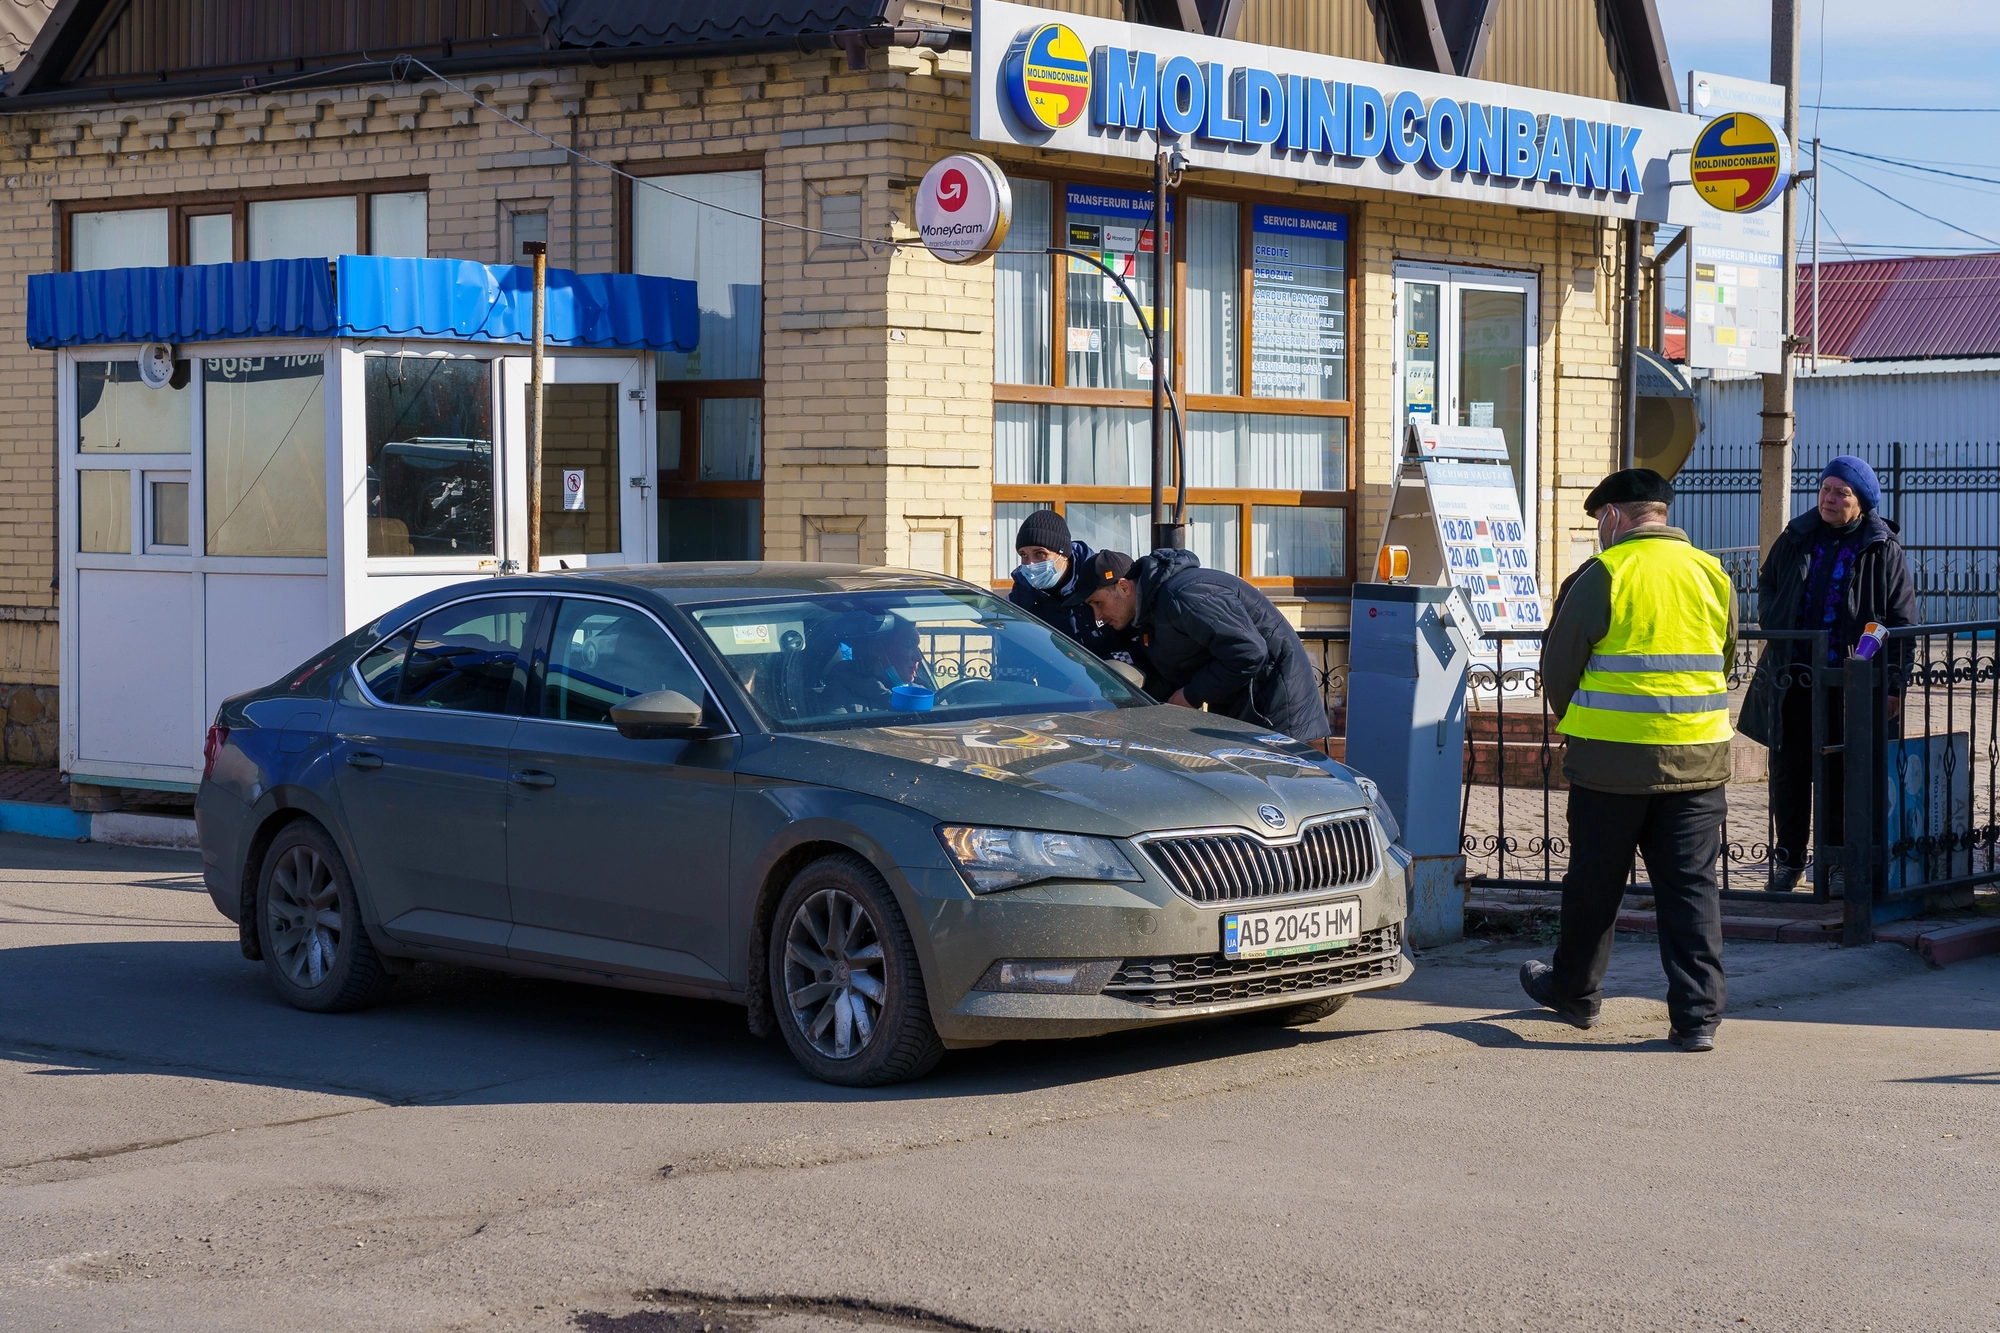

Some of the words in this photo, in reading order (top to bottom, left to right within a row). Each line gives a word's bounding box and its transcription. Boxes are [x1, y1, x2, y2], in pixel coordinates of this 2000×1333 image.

[1027, 67, 1089, 85] MOLDINDCONBANK
[1035, 96, 1046, 105] S.A.
[1712, 86, 1783, 109] MOLDINDCONBANK
[1103, 45, 1645, 196] MOLDINDCONBANK
[1694, 155, 1777, 170] MOLDINDCONBANK
[1704, 185, 1718, 193] S.A.
[1067, 193, 1130, 209] TRANSFERURI
[1263, 215, 1298, 228] SERVICII
[1300, 218, 1338, 232] BANCARE
[928, 238, 952, 248] transfer
[952, 238, 961, 246] de
[961, 237, 974, 246] bani
[1111, 235, 1133, 243] MoneyGram
[1255, 245, 1289, 258] CREDITE
[1697, 246, 1748, 262] TRANSFERURI
[1255, 267, 1294, 281] DEPOZITE
[1254, 289, 1291, 303] CARDURI
[1291, 292, 1328, 307] BANCARE
[1254, 311, 1290, 323] SERVICII
[1290, 313, 1334, 328] COMUNALE
[1254, 332, 1309, 347] TRANSFERURI
[1254, 361, 1288, 372] SERVICII
[1289, 362, 1300, 373] DE
[1436, 468, 1469, 480] SCHIMB
[1470, 470, 1508, 481] VALUTAR
[1239, 918, 1270, 948] AB
[1275, 911, 1321, 943] 2045
[1326, 907, 1353, 937] HM
[1227, 939, 1237, 948] UA
